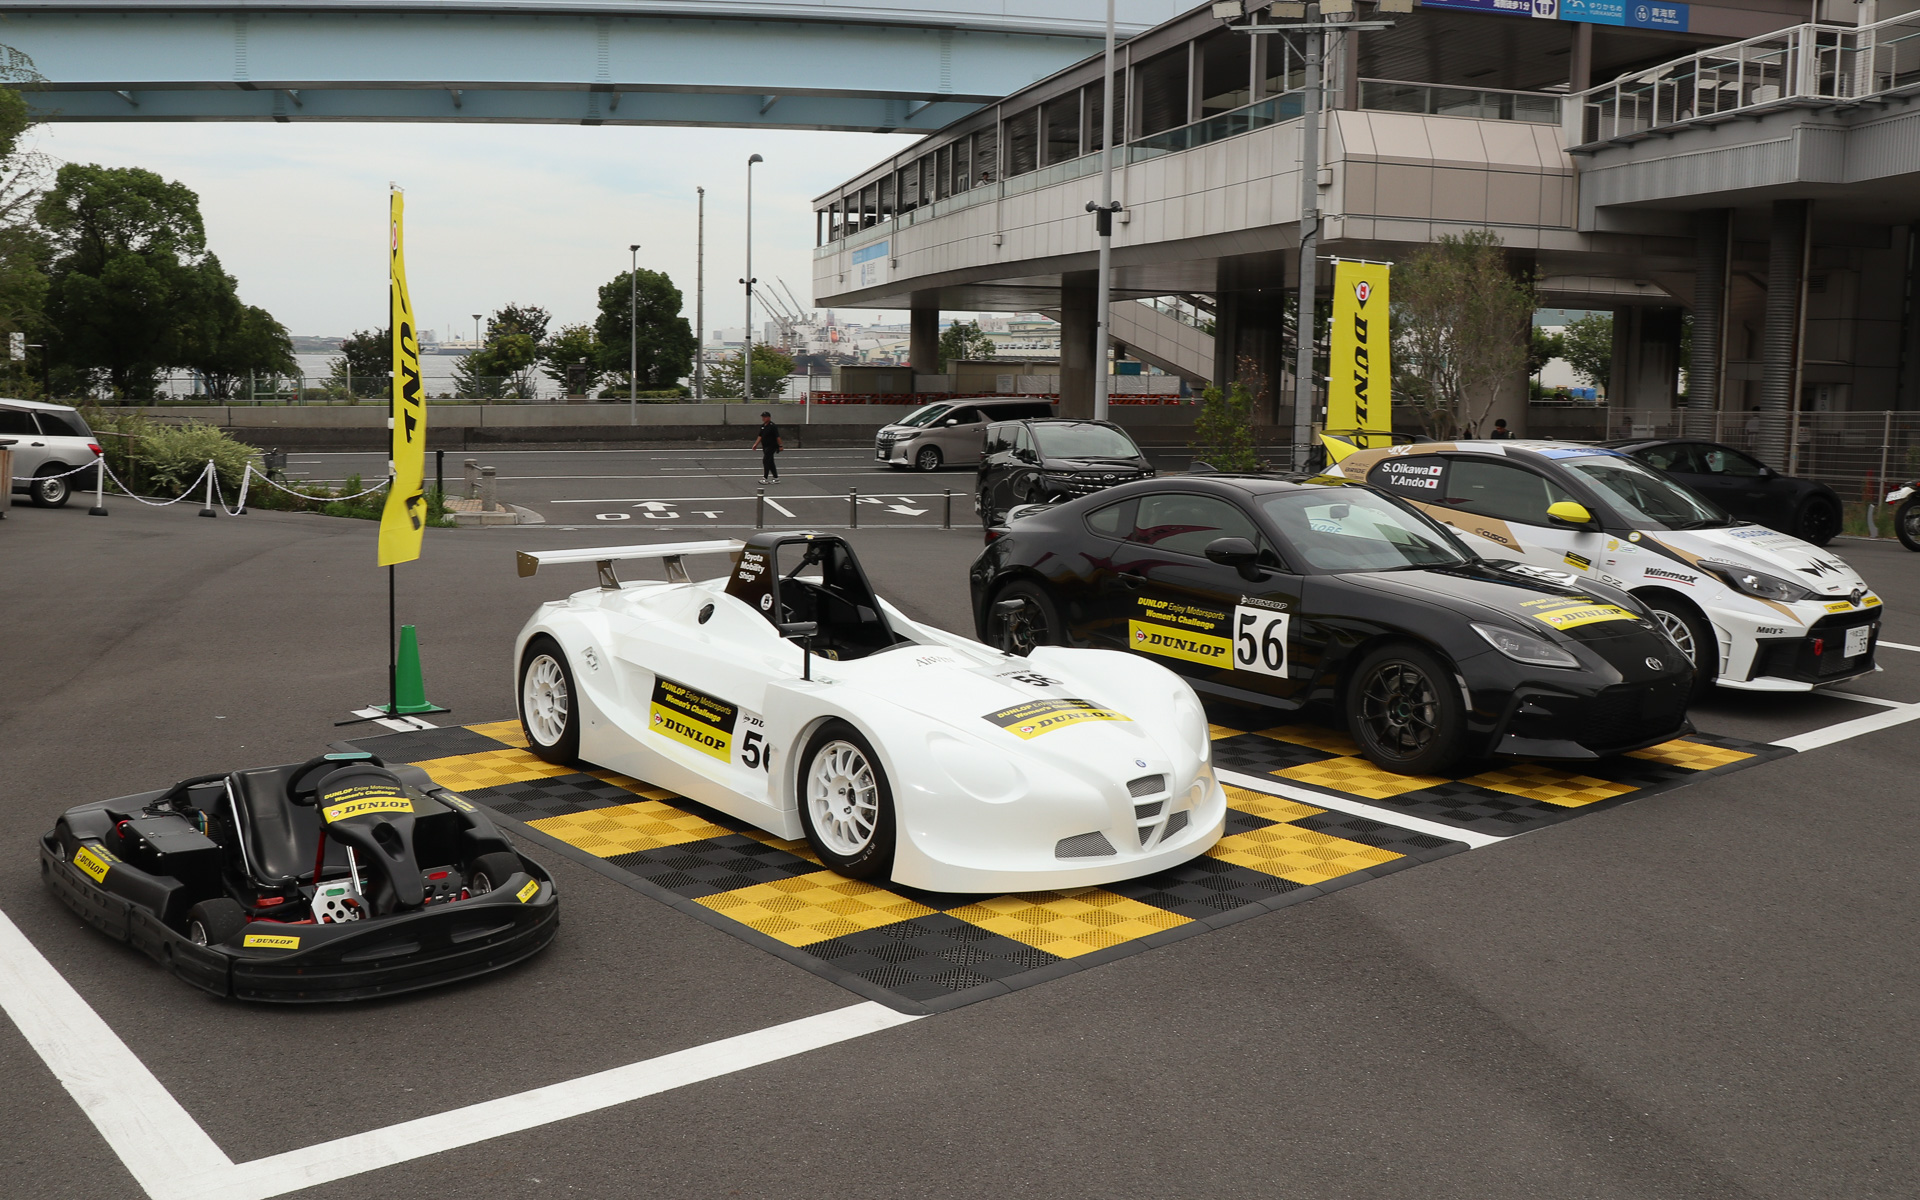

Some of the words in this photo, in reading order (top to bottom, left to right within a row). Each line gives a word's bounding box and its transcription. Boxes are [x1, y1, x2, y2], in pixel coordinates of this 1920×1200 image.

[1589, 2, 1623, 12] ゆりかもめ
[1651, 7, 1677, 19] 青海駅
[1382, 463, 1429, 475] S.Oikawa
[1390, 475, 1425, 488] Y.Ando
[595, 511, 725, 521] OUT
[744, 551, 764, 562] Toyota
[740, 561, 766, 575] Mobility
[738, 571, 756, 583] Shiga
[1137, 597, 1168, 609] DUNLOP
[1168, 602, 1186, 614] Enjoy
[1186, 605, 1225, 621] Motorsports
[1247, 598, 1288, 610] DUNLOP
[1146, 609, 1177, 622] Women's
[1177, 615, 1215, 630] Challenge
[1563, 609, 1621, 621] DUNLOP
[1756, 626, 1784, 634] Moty's
[1149, 633, 1226, 658] DUNLOP
[1237, 613, 1284, 671] 56
[661, 681, 686, 696] DUNLOP
[685, 690, 700, 703] Enjoy
[700, 696, 732, 715] Motorsports
[665, 693, 691, 710] Women's
[690, 704, 722, 722] Challenge
[997, 704, 1033, 718] DUNLOP
[1014, 706, 1052, 719] Women's
[1038, 712, 1116, 728] DUNLOP
[664, 718, 726, 750] DUNLOP
[324, 788, 354, 800] DUNLOP
[334, 792, 364, 802] Women's
[344, 801, 409, 813] DUNLOP
[80, 855, 105, 875] DUNLOP
